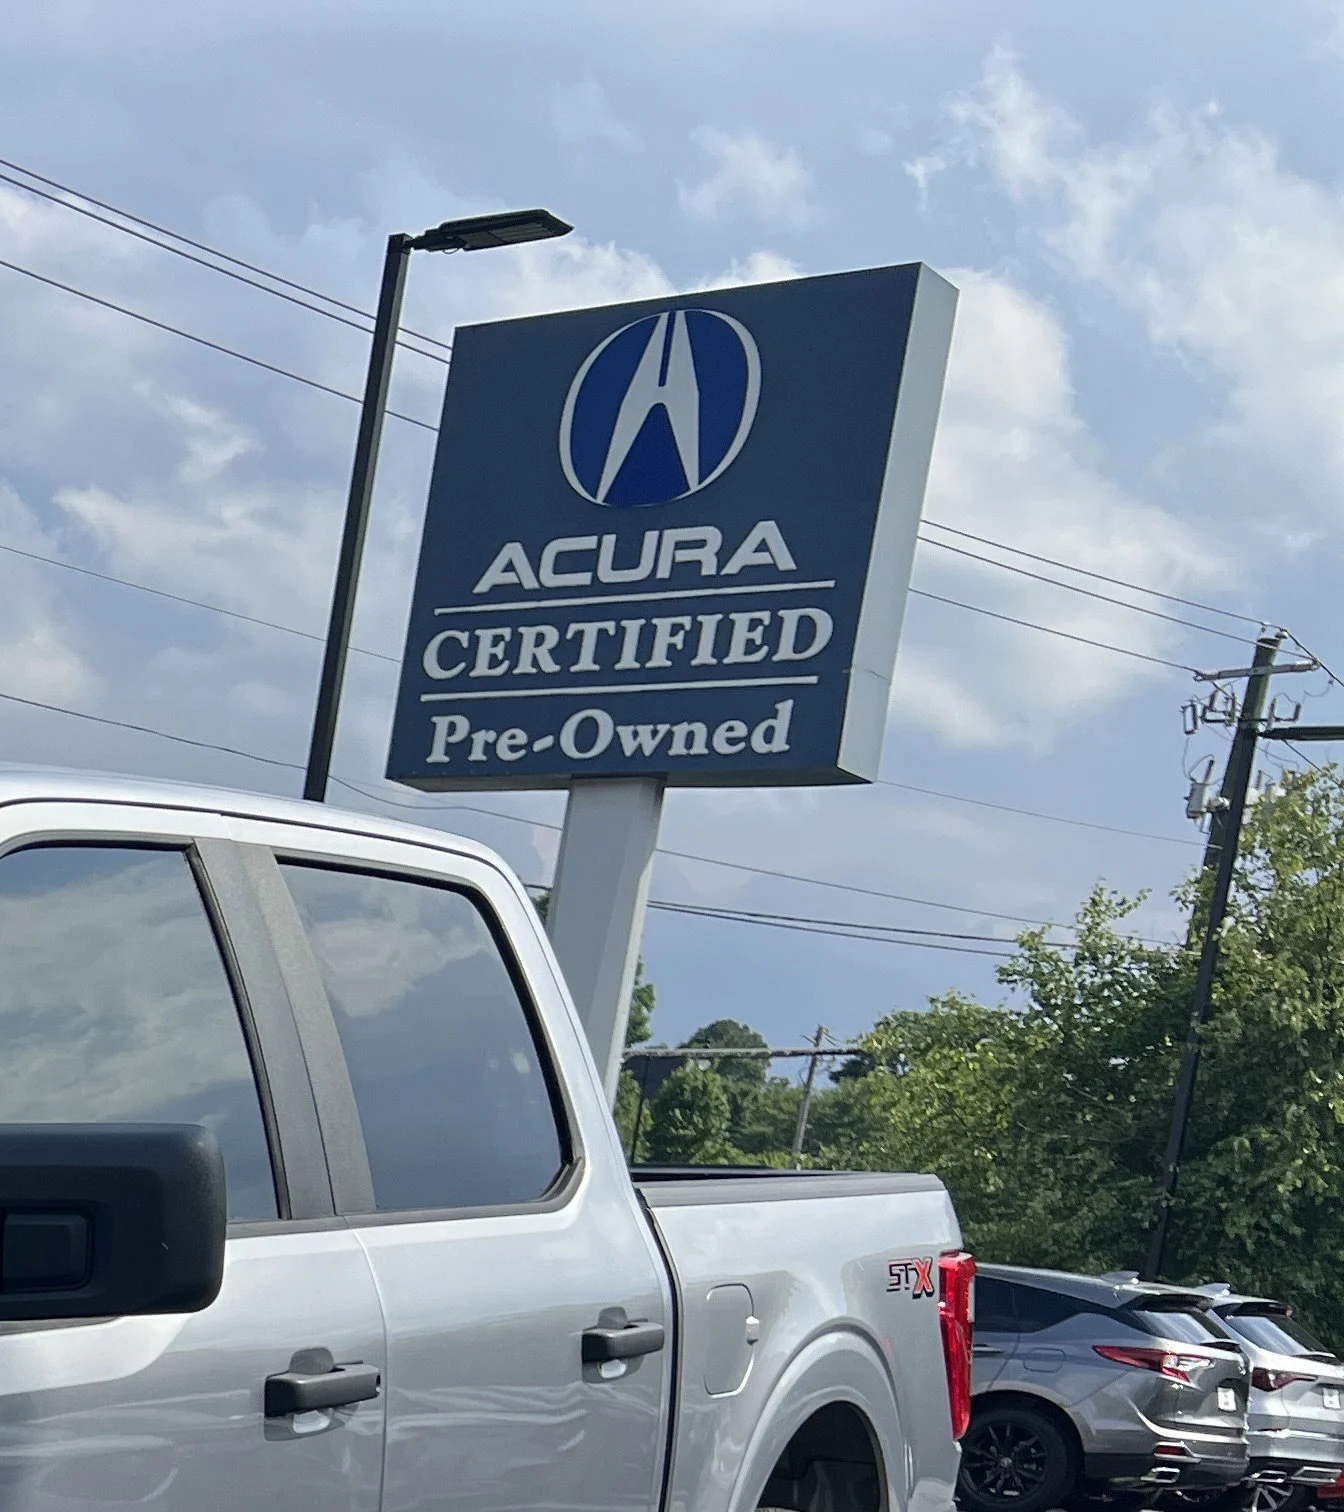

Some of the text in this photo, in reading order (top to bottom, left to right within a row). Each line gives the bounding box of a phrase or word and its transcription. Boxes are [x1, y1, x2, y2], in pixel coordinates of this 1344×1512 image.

[471, 520, 798, 594] ACURA
[421, 607, 834, 680] CERTIFIED
[425, 699, 795, 764] Pre-Owned
[886, 1256, 935, 1299] STX
